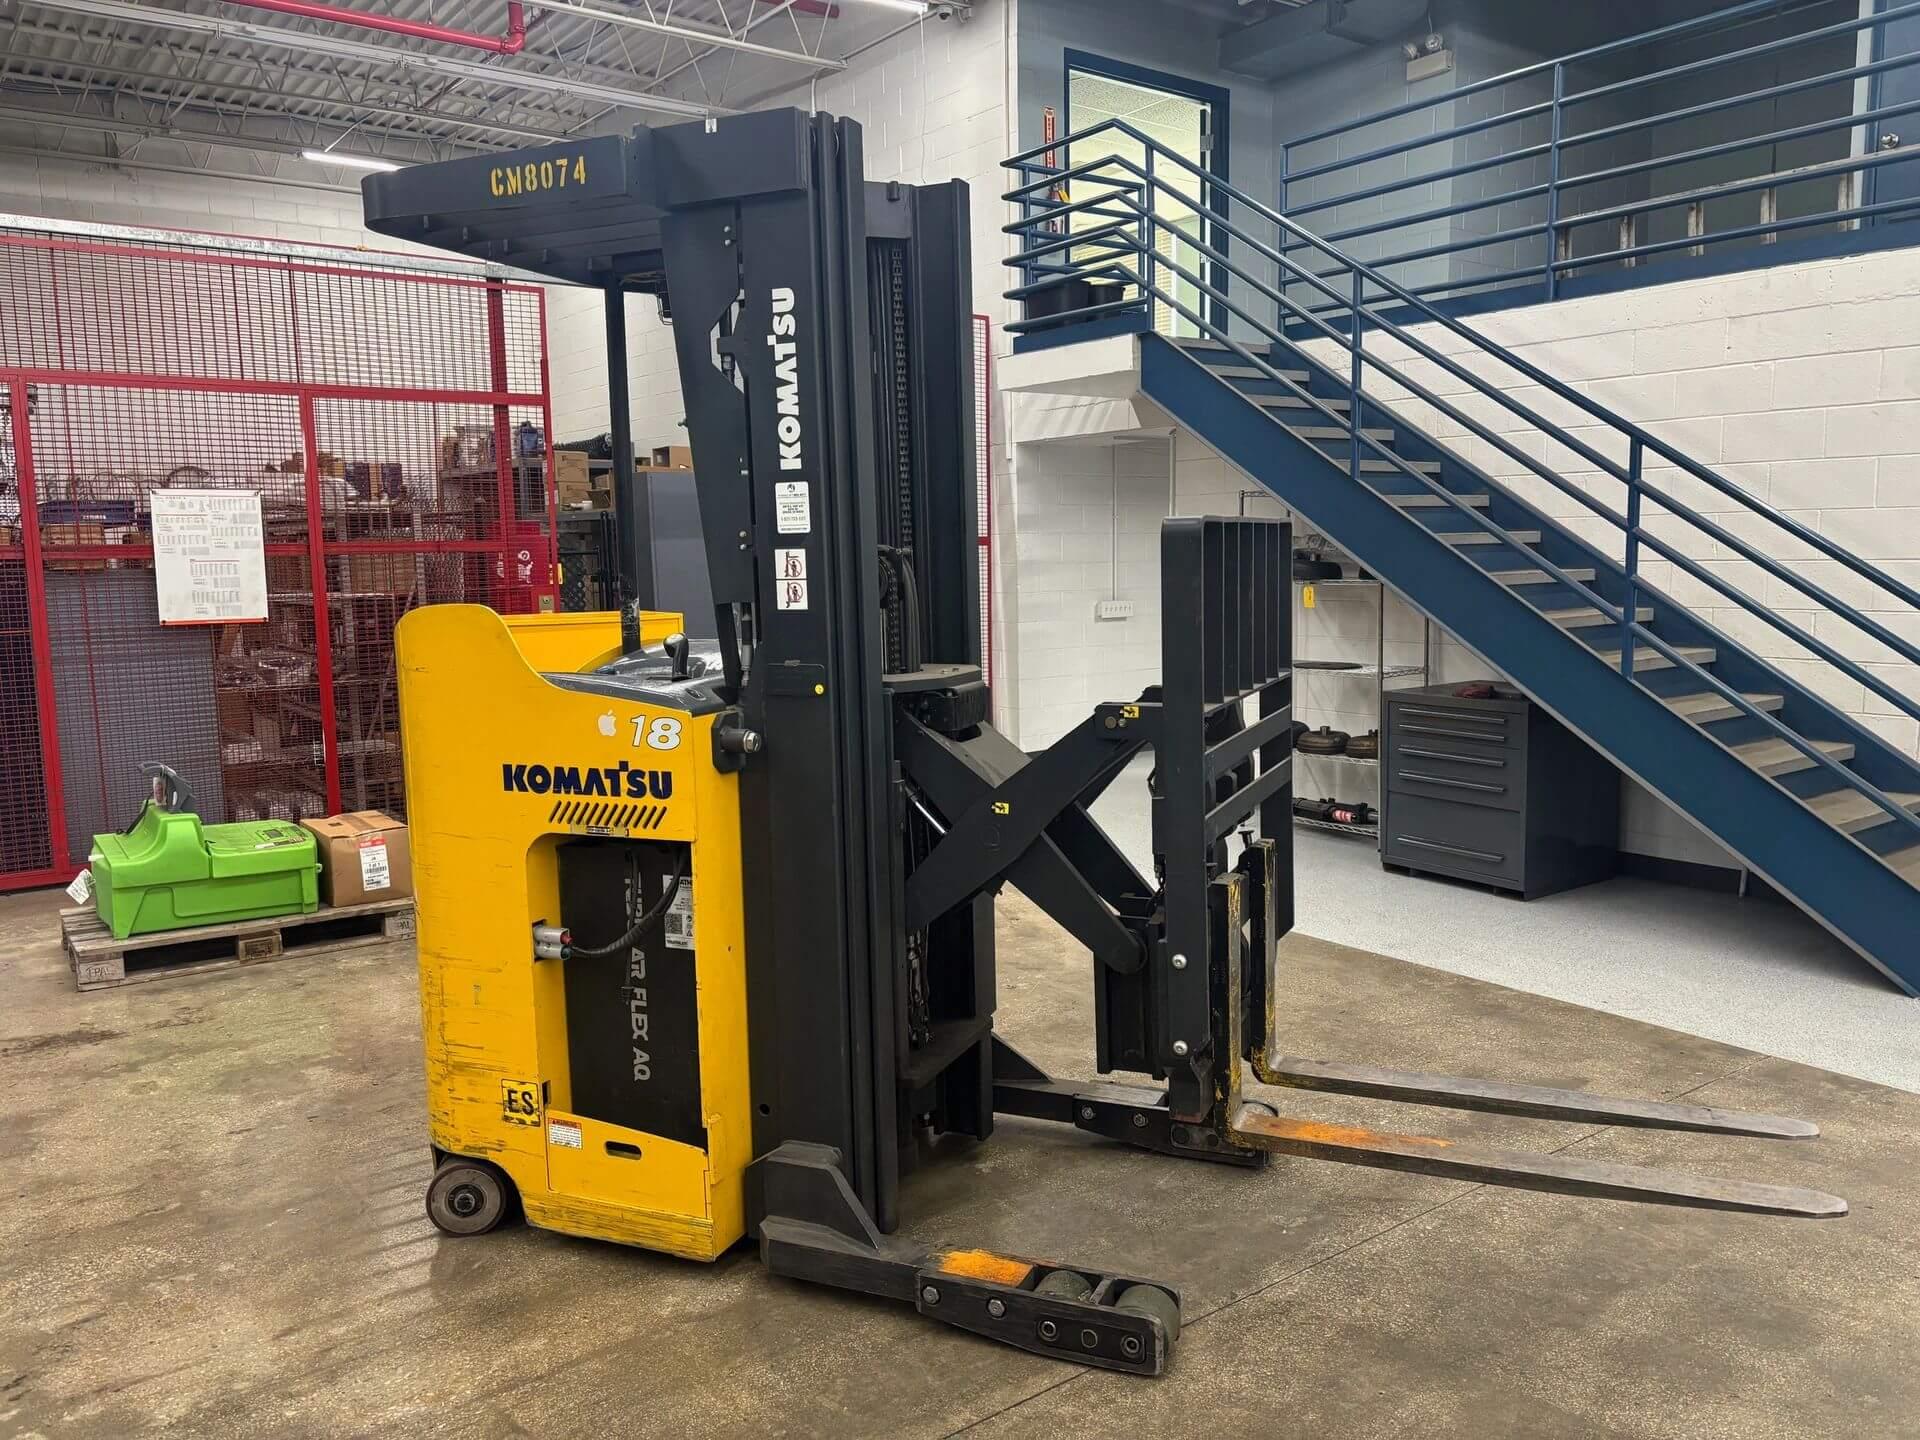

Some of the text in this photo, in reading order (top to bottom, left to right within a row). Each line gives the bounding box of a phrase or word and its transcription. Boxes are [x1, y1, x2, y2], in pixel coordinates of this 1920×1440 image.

[490, 155, 587, 197] CM8074
[767, 287, 803, 470] KOMATSU
[629, 714, 683, 751] 18
[502, 760, 673, 800] KOMATSU
[630, 986, 649, 1041] FLEX
[632, 1046, 652, 1081] AQ
[507, 1089, 535, 1116] ES
